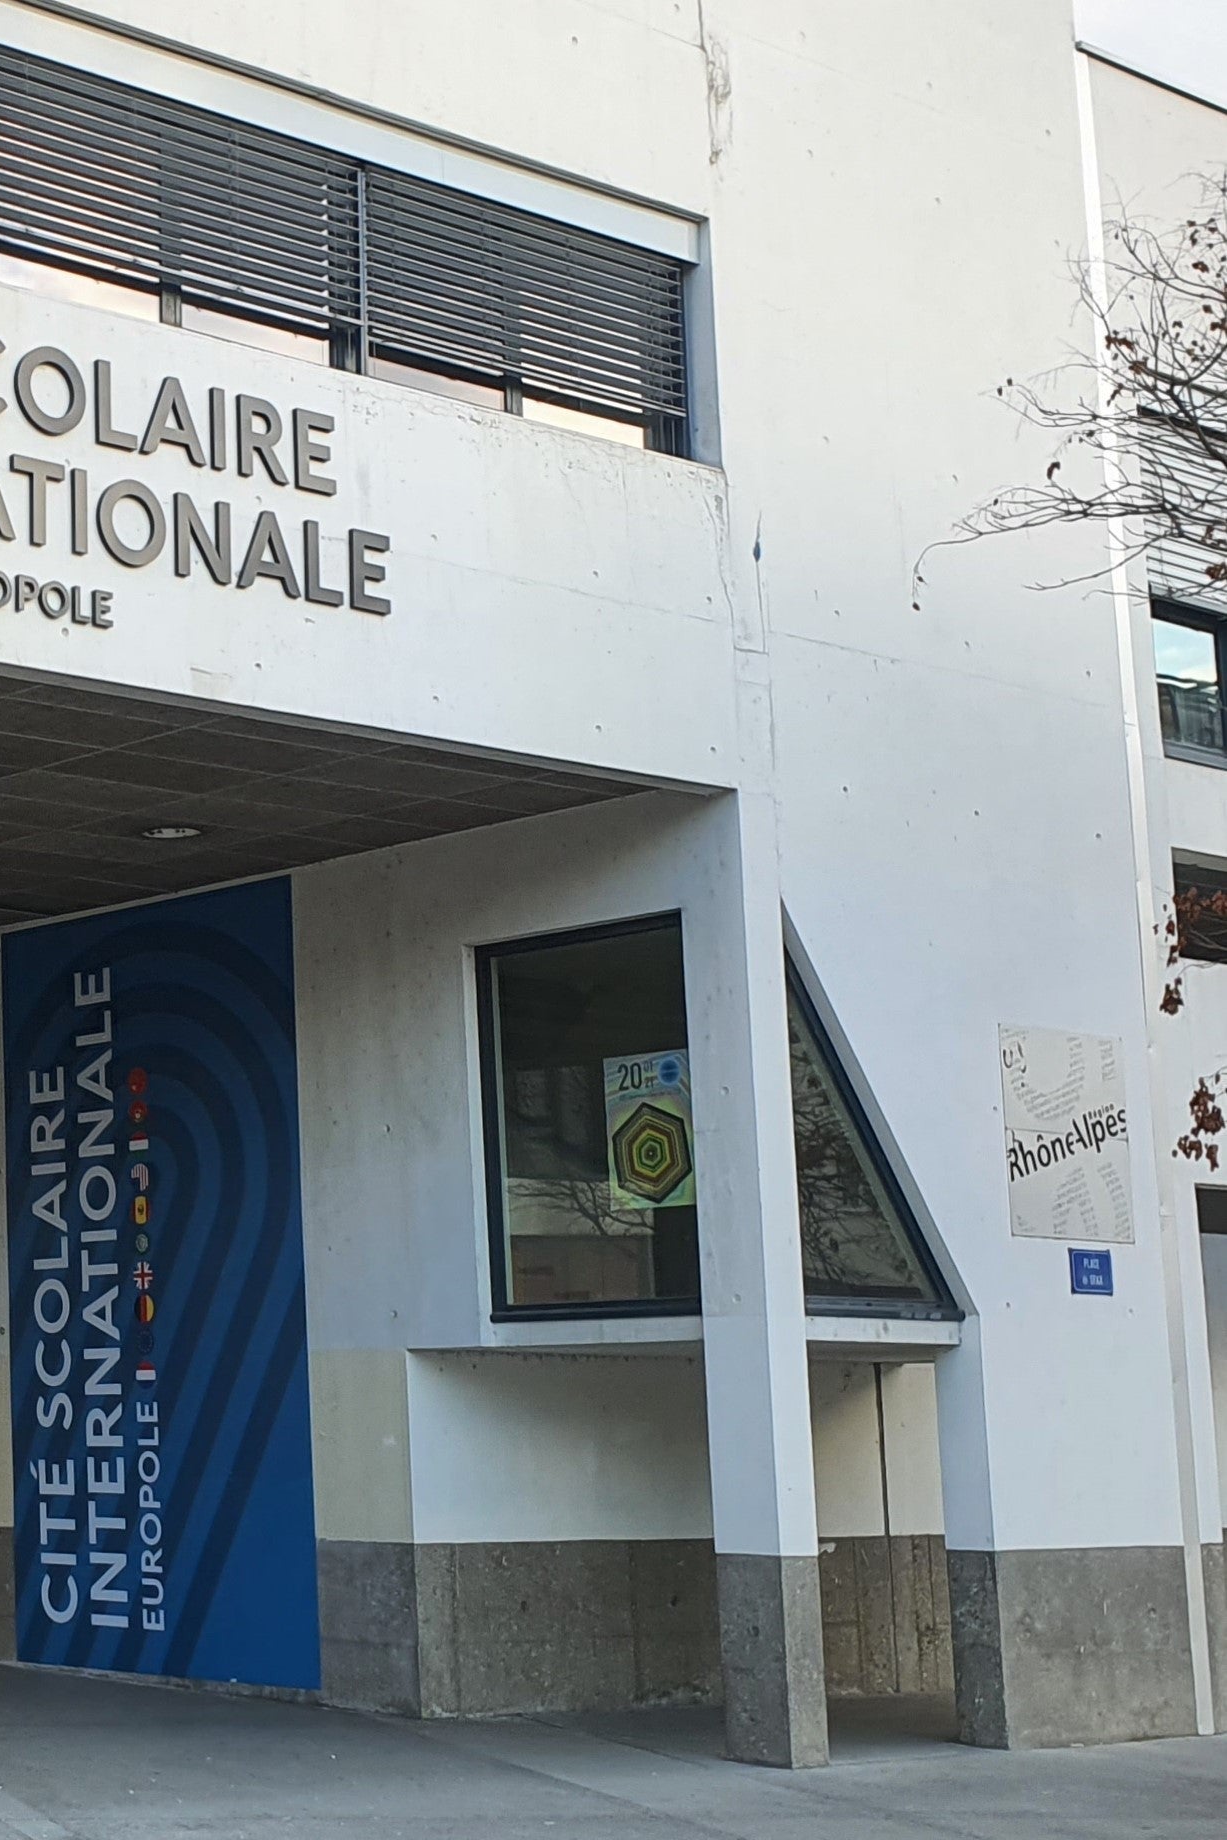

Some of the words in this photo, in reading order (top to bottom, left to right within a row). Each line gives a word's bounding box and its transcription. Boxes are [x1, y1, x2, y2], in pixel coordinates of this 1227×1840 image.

[29, 1065, 73, 1431] SCOLAIRE
[74, 966, 129, 1629] INTERNATIONALE
[29, 1458, 79, 1624] CITÉ
[135, 1401, 166, 1632] EUROPOLE
